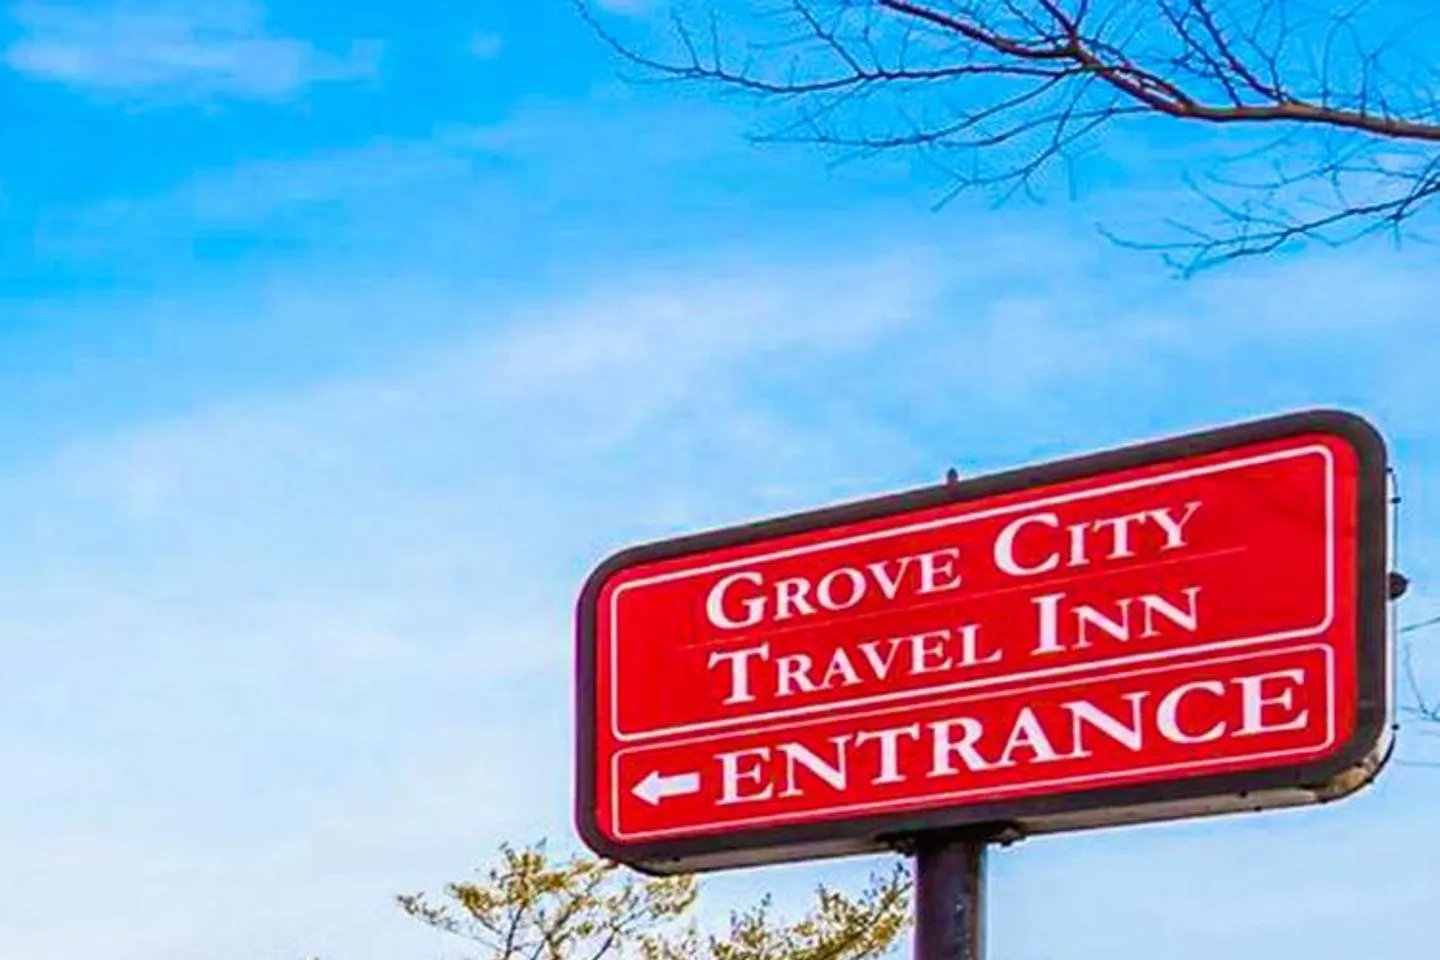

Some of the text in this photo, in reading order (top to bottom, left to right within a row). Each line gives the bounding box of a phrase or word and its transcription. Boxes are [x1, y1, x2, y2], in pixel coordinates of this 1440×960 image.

[706, 500, 1203, 630] GROVE CITY
[707, 586, 1203, 705] TRAVEL INN
[714, 668, 1310, 806] ENTRANCE
